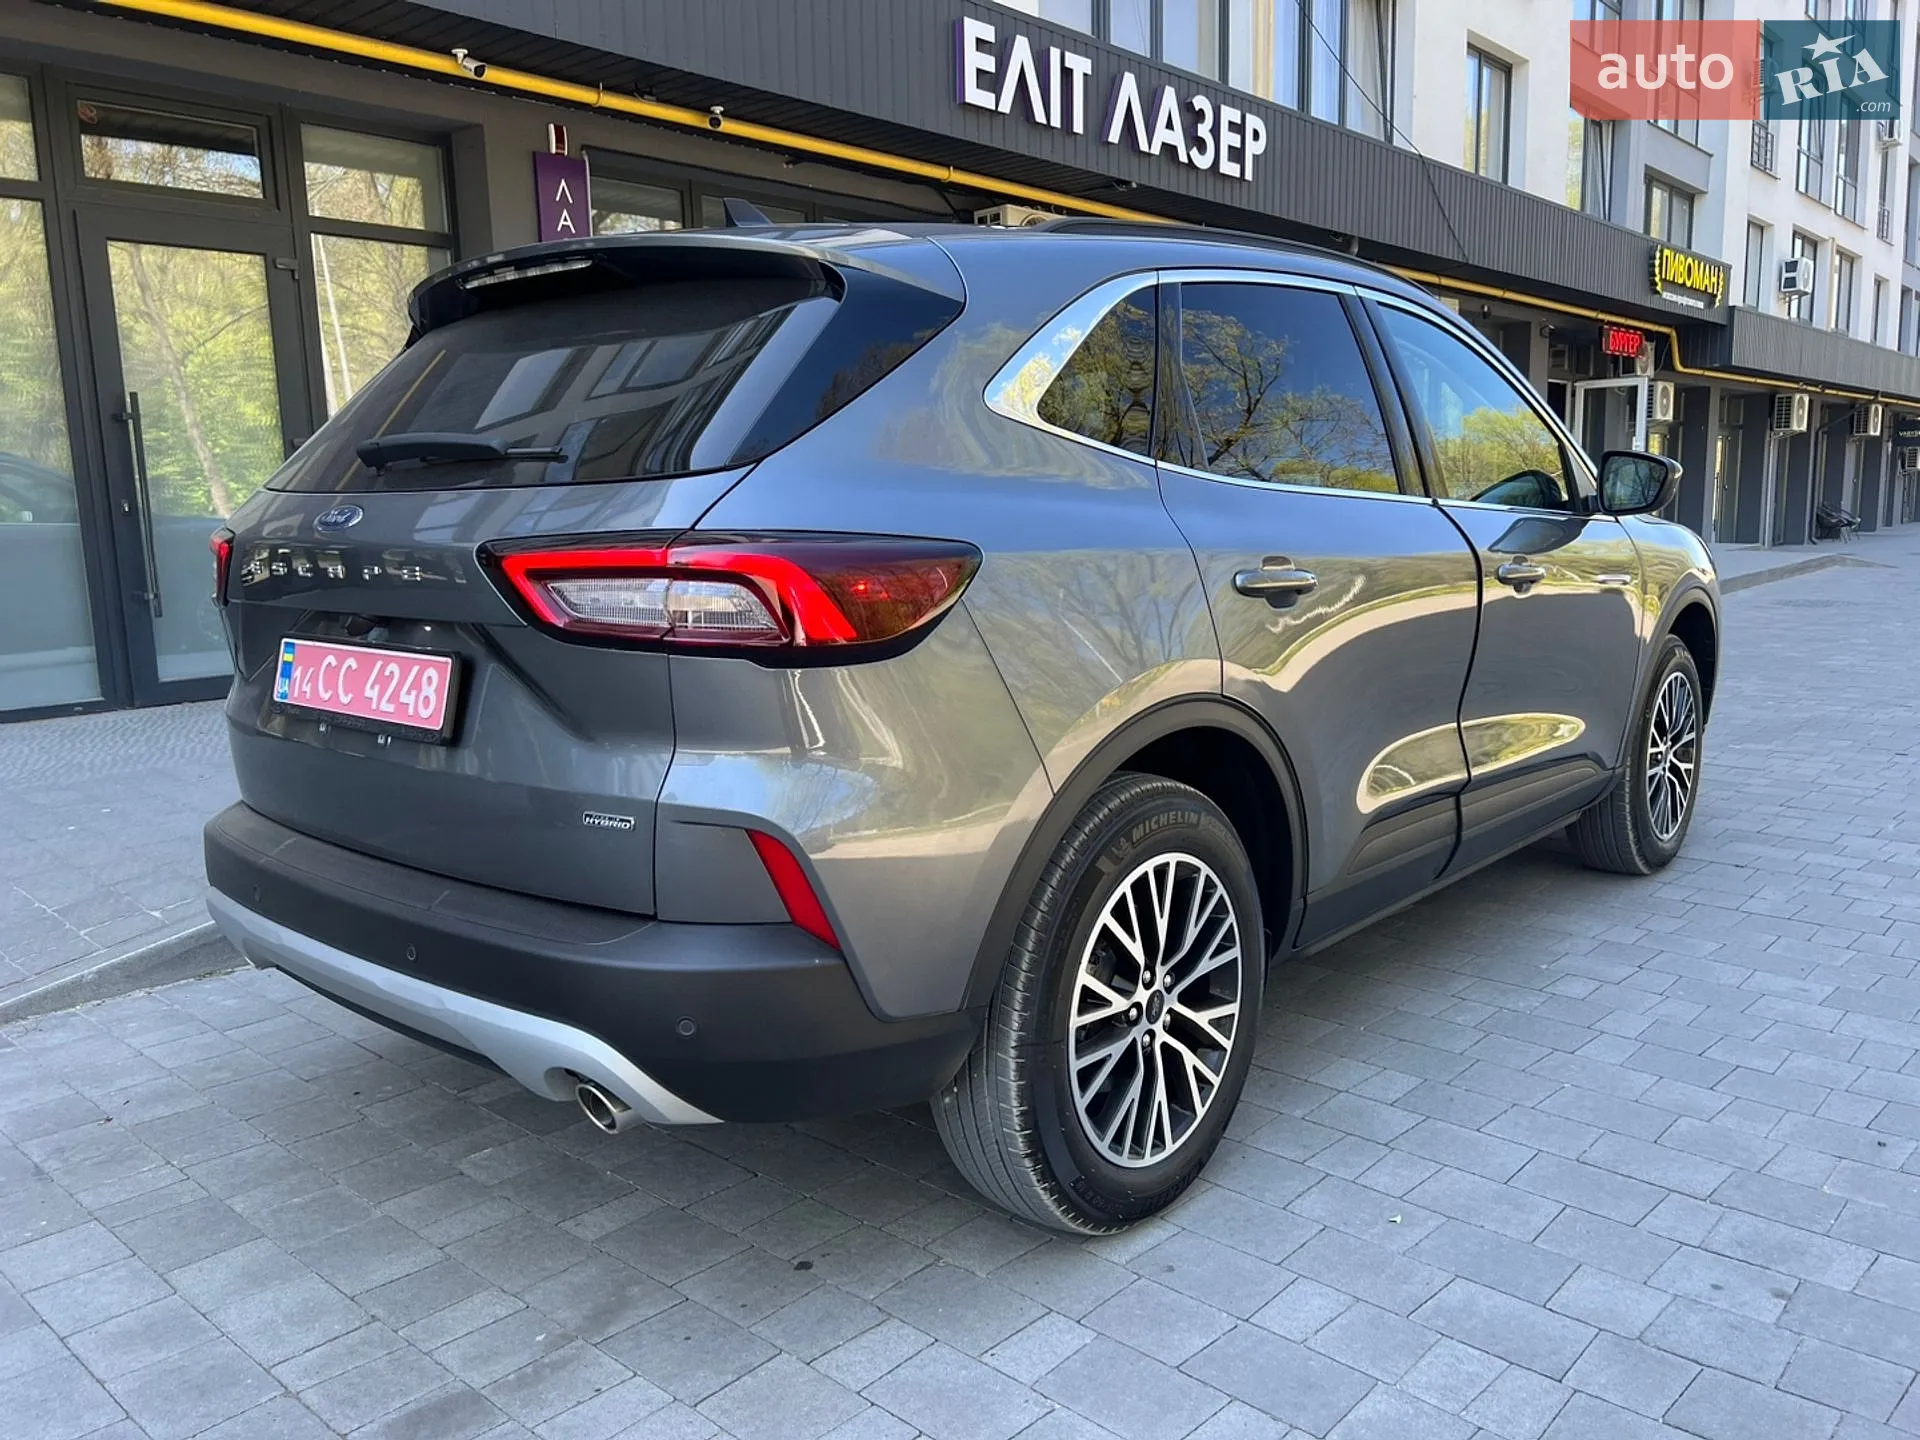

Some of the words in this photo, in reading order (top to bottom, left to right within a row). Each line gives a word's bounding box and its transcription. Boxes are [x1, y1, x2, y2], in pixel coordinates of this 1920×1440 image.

[959, 16, 1092, 135] ЕЛІТ
[1104, 71, 1267, 182] ЛАЗЕР
[1662, 248, 1719, 296] ПИВОМАН
[1609, 330, 1640, 353] БУРГЕР
[363, 660, 440, 719] 4248
[1131, 810, 1199, 843] MICHELIN
